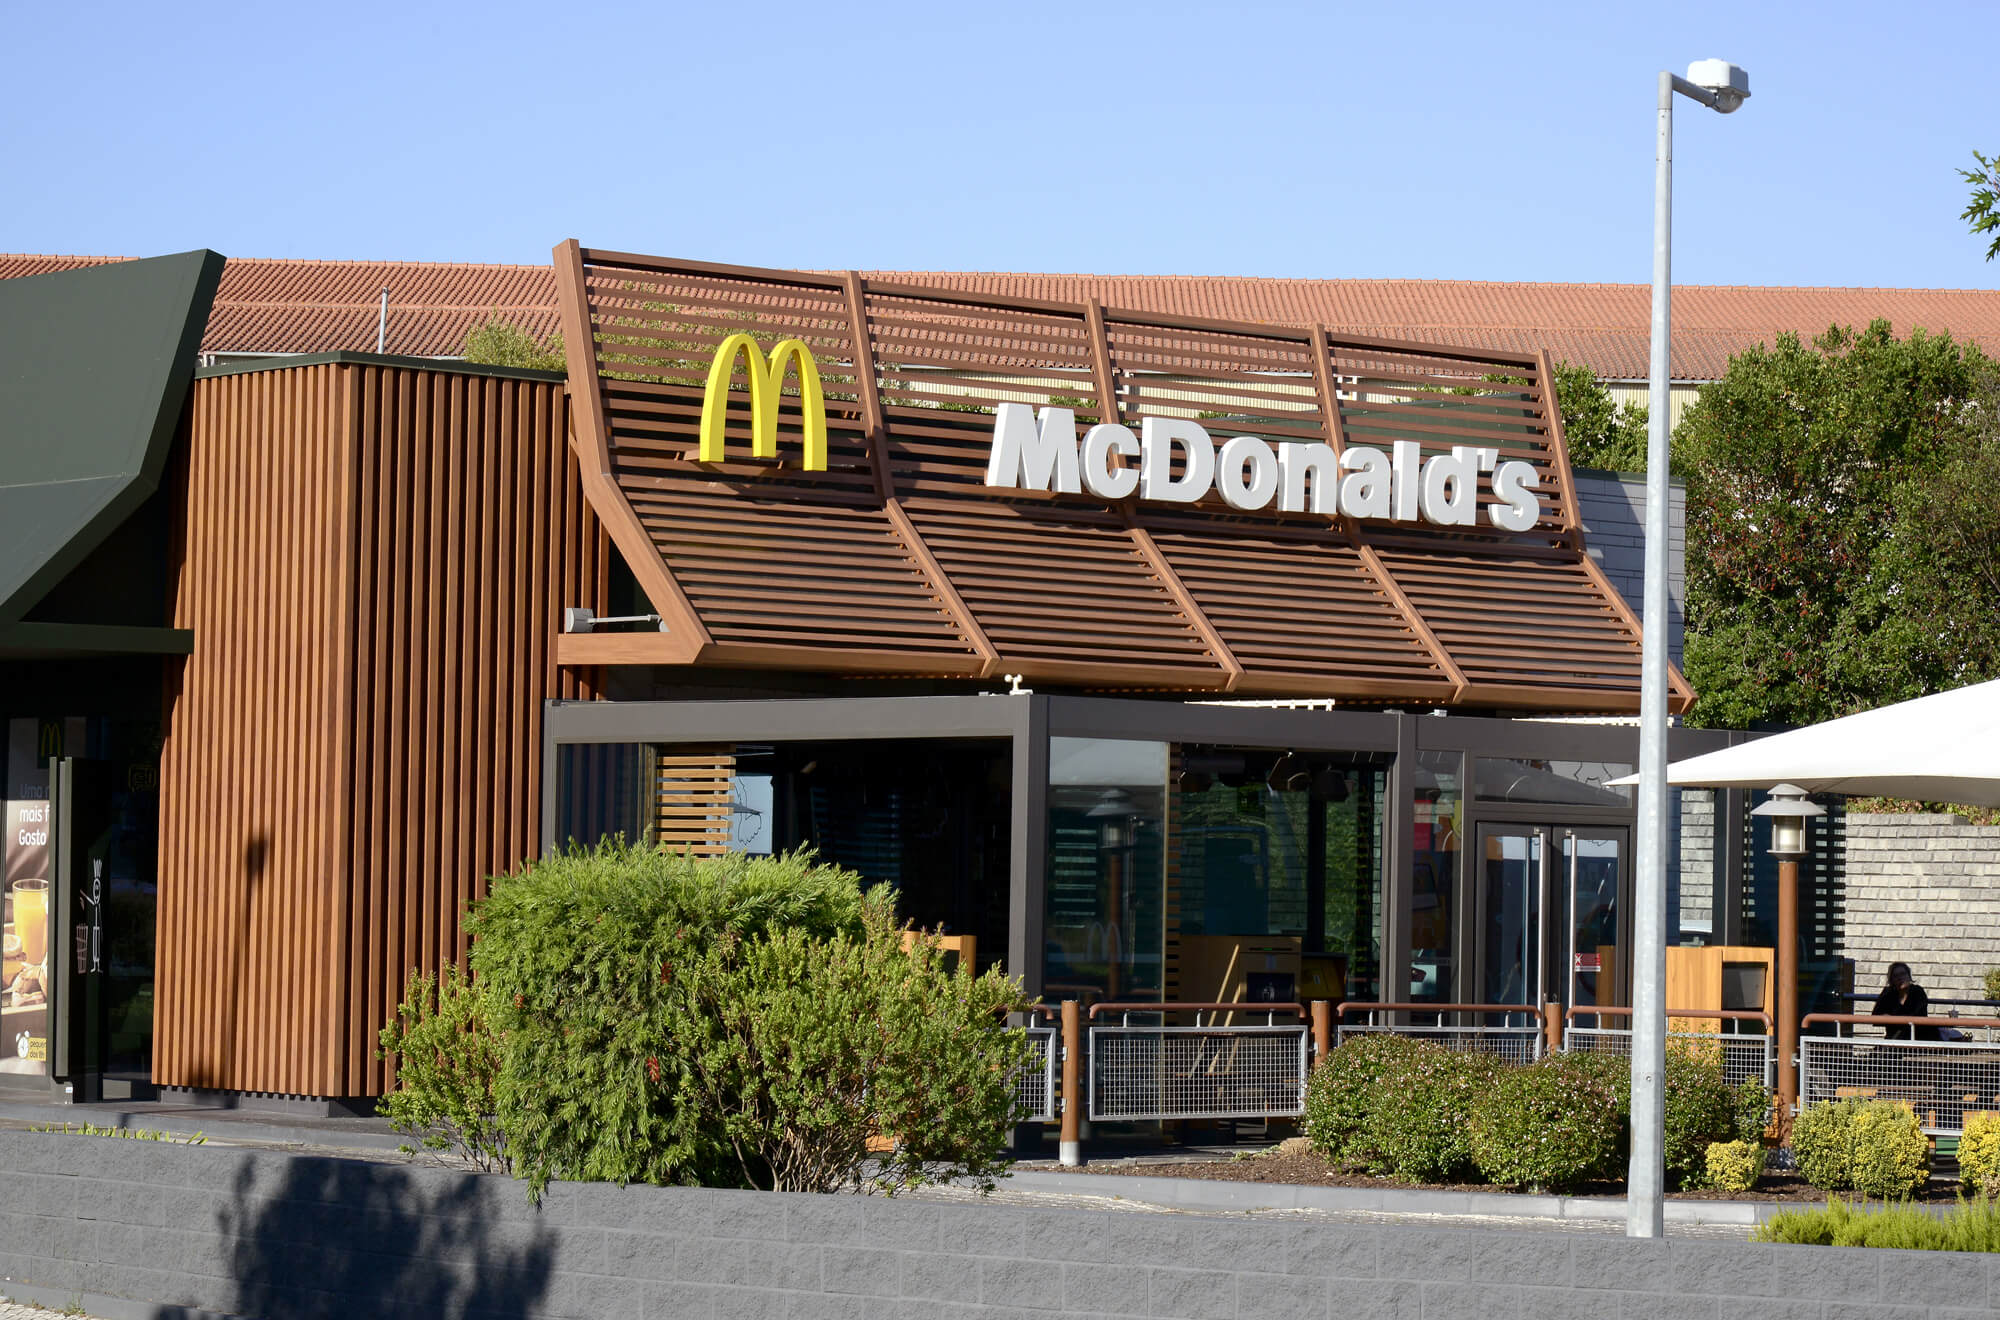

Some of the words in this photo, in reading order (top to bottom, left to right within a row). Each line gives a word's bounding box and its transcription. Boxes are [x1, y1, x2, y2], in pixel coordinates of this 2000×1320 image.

[985, 402, 1540, 533] McDonald's
[20, 805, 42, 822] mais
[18, 828, 47, 846] Gosto
